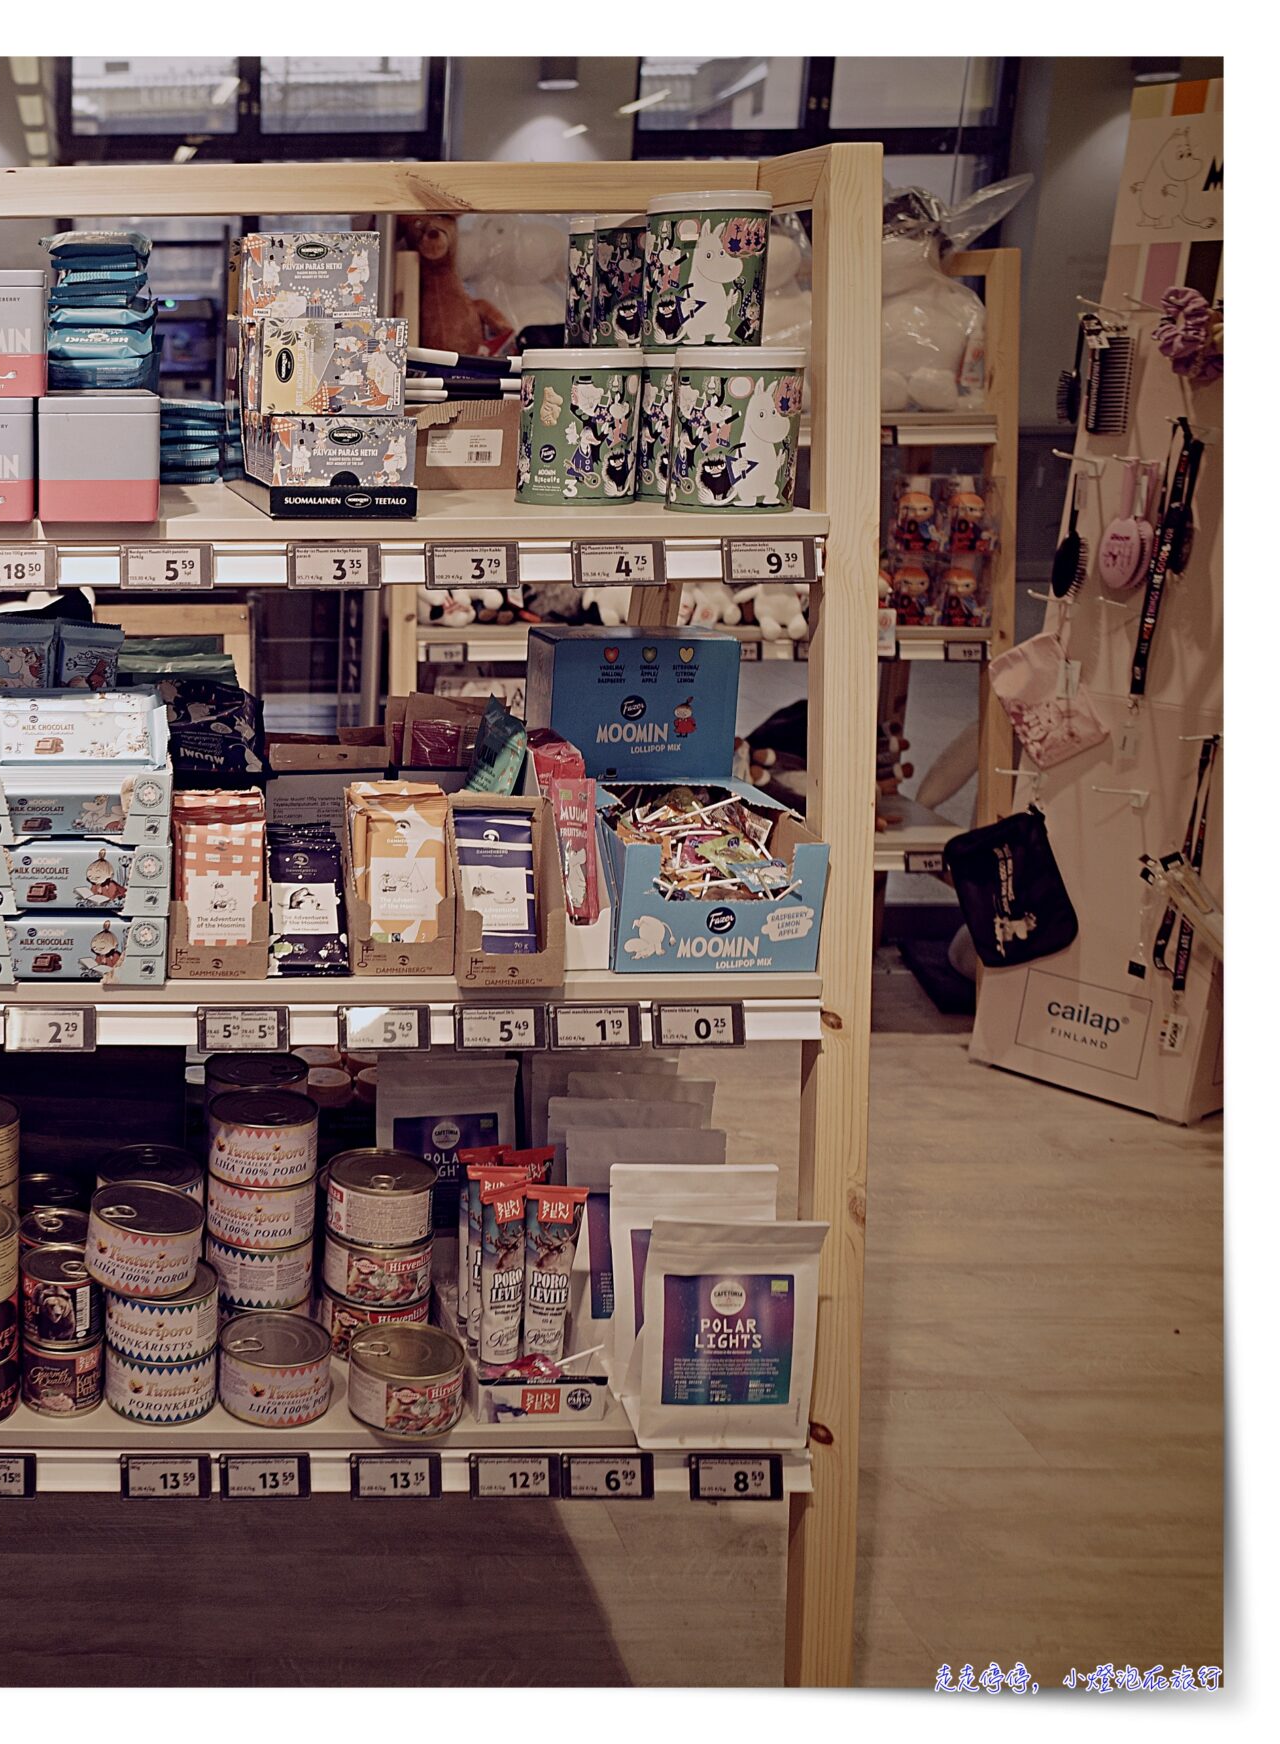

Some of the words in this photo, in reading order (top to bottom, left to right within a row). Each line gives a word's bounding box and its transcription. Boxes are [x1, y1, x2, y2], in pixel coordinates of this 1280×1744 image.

[306, 262, 325, 270] PARAS
[326, 262, 343, 270] HETKI
[338, 448, 359, 456] PARAS
[360, 448, 378, 456] HETKI
[284, 497, 341, 505] SUOMALAINEN
[4, 563, 25, 580] 18
[28, 563, 41, 572] 50
[165, 560, 179, 581] 5
[182, 560, 195, 569] 59
[333, 559, 346, 580] 3
[349, 560, 362, 569] 35
[471, 558, 485, 580] 3
[487, 559, 501, 568] 79
[615, 556, 632, 577] 4
[634, 556, 647, 565] 75
[767, 553, 783, 575] 9
[785, 553, 798, 562] 39
[623, 699, 645, 715] Fazer
[21, 723, 36, 732] MILK
[38, 723, 75, 732] CHOCOLATE
[596, 723, 669, 744] MOOMIN
[631, 744, 666, 754] LOLLIPOP
[667, 743, 682, 752] MIX
[14, 867, 30, 875] MILK
[31, 867, 69, 875] CHOCOLATE
[709, 911, 734, 929] Fazer
[770, 911, 809, 923] RASPBERRY
[777, 920, 801, 930] LEMON
[778, 927, 799, 937] APPLE
[20, 938, 35, 946] MILK
[36, 938, 74, 946] CHOCOLATE
[677, 936, 760, 958] MOOMIN
[716, 959, 755, 970] LOLLIPOP
[757, 957, 772, 967] MIX
[48, 1022, 62, 1043] 2
[65, 1022, 78, 1032] 29
[222, 1024, 232, 1038] 5
[258, 1024, 267, 1039] 5
[383, 1022, 397, 1043] 5
[399, 1022, 412, 1031] 49
[500, 1021, 513, 1042] 5
[515, 1021, 529, 1030] 49
[596, 1019, 607, 1041] 1
[611, 1020, 622, 1029] 19
[695, 1018, 711, 1040] 0
[714, 1019, 726, 1028] 25
[1050, 1026, 1108, 1050] FINLAND
[227, 1141, 306, 1165] Tunturiporo
[215, 1157, 236, 1173] LIHA
[240, 1166, 269, 1177] 100%
[272, 1161, 308, 1177] POROA
[224, 1221, 250, 1237] 100%
[254, 1227, 293, 1238] POROA
[107, 1245, 189, 1273] Tunturiporo
[93, 1258, 116, 1278] LIHA
[120, 1271, 151, 1285] 100%
[154, 1270, 189, 1285] POROA
[494, 1269, 523, 1289] PORO
[533, 1270, 568, 1288] PORO
[529, 1286, 569, 1304] LEVITE
[115, 1310, 193, 1341] Tunturiporo
[700, 1318, 757, 1334] POLAR
[695, 1334, 762, 1349] LIGHTS
[248, 1403, 278, 1415] LIHA
[282, 1403, 310, 1415] 100%
[2, 1472, 15, 1483] 15
[160, 1473, 180, 1490] 13
[259, 1473, 279, 1490] 13
[390, 1472, 410, 1489] 13
[509, 1472, 529, 1489] 12
[605, 1470, 620, 1491] 6
[734, 1471, 749, 1492] 8
